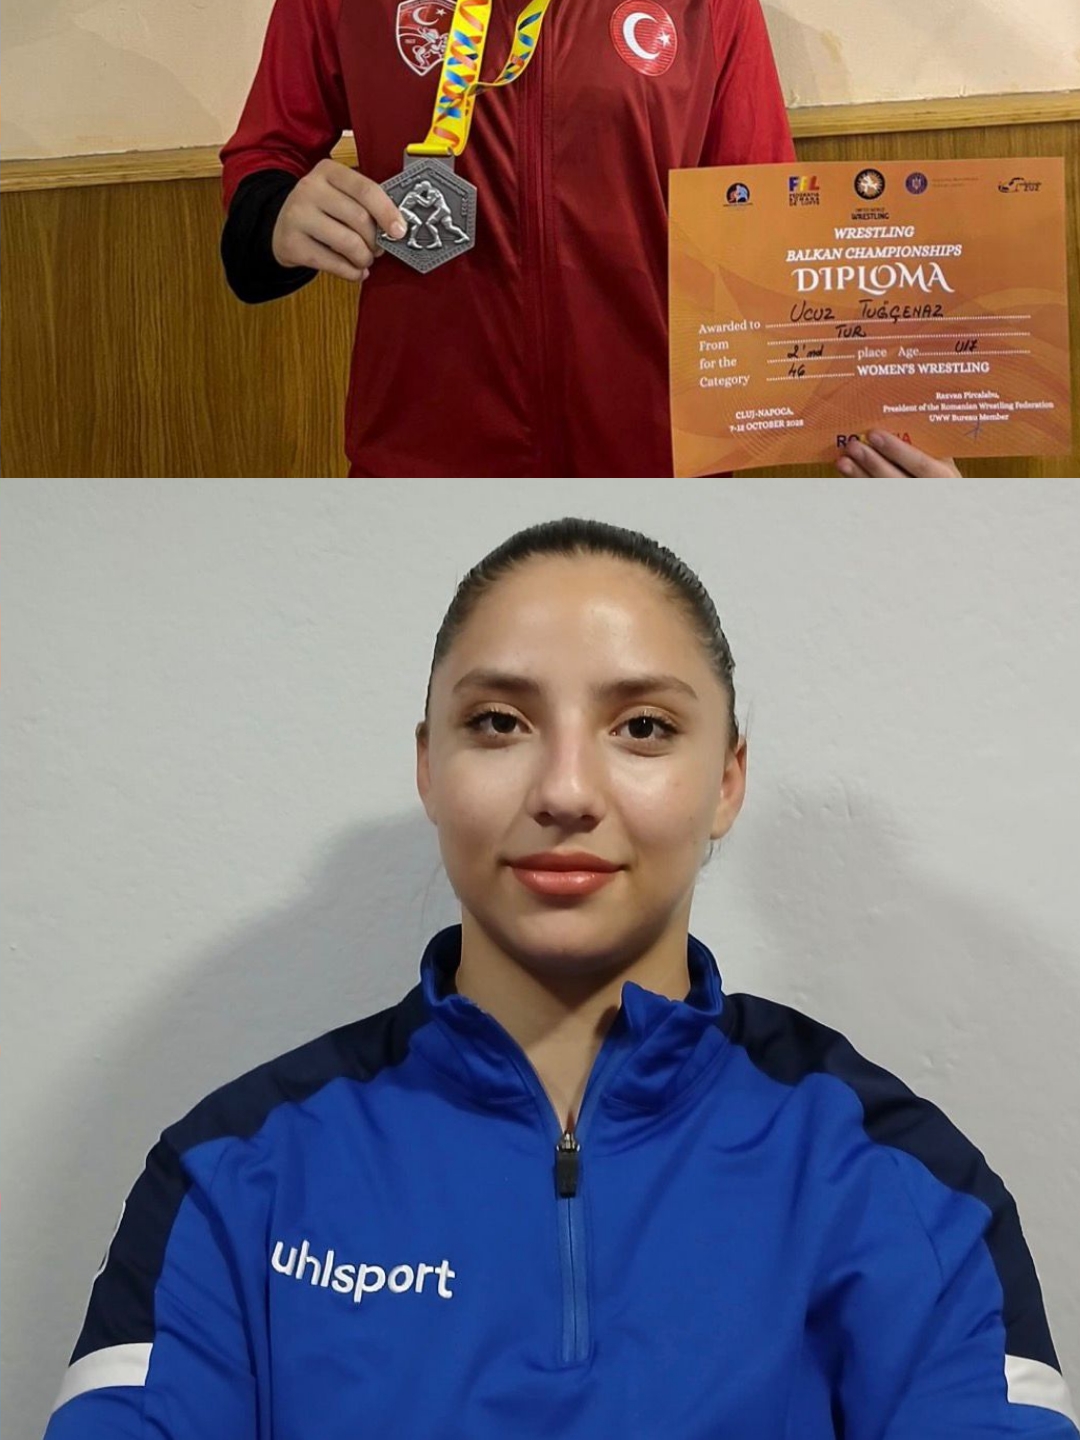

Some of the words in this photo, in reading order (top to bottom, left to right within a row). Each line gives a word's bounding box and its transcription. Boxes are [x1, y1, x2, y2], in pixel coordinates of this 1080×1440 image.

[834, 225, 915, 240] WRESTLING
[786, 247, 842, 263] BALKAN
[844, 243, 963, 261] CHAMPIONSHIPS
[791, 261, 955, 296] DIPLOMA
[699, 321, 748, 335] Awarded
[749, 320, 761, 331] to
[699, 340, 730, 352] From
[857, 345, 888, 361] place
[898, 344, 920, 359] Age
[699, 358, 717, 371] for
[718, 356, 737, 369] the
[857, 363, 916, 377] WOMEN'S
[918, 361, 991, 376] WRESTLING
[699, 374, 751, 389] Category
[270, 1238, 456, 1304] uhlsport
